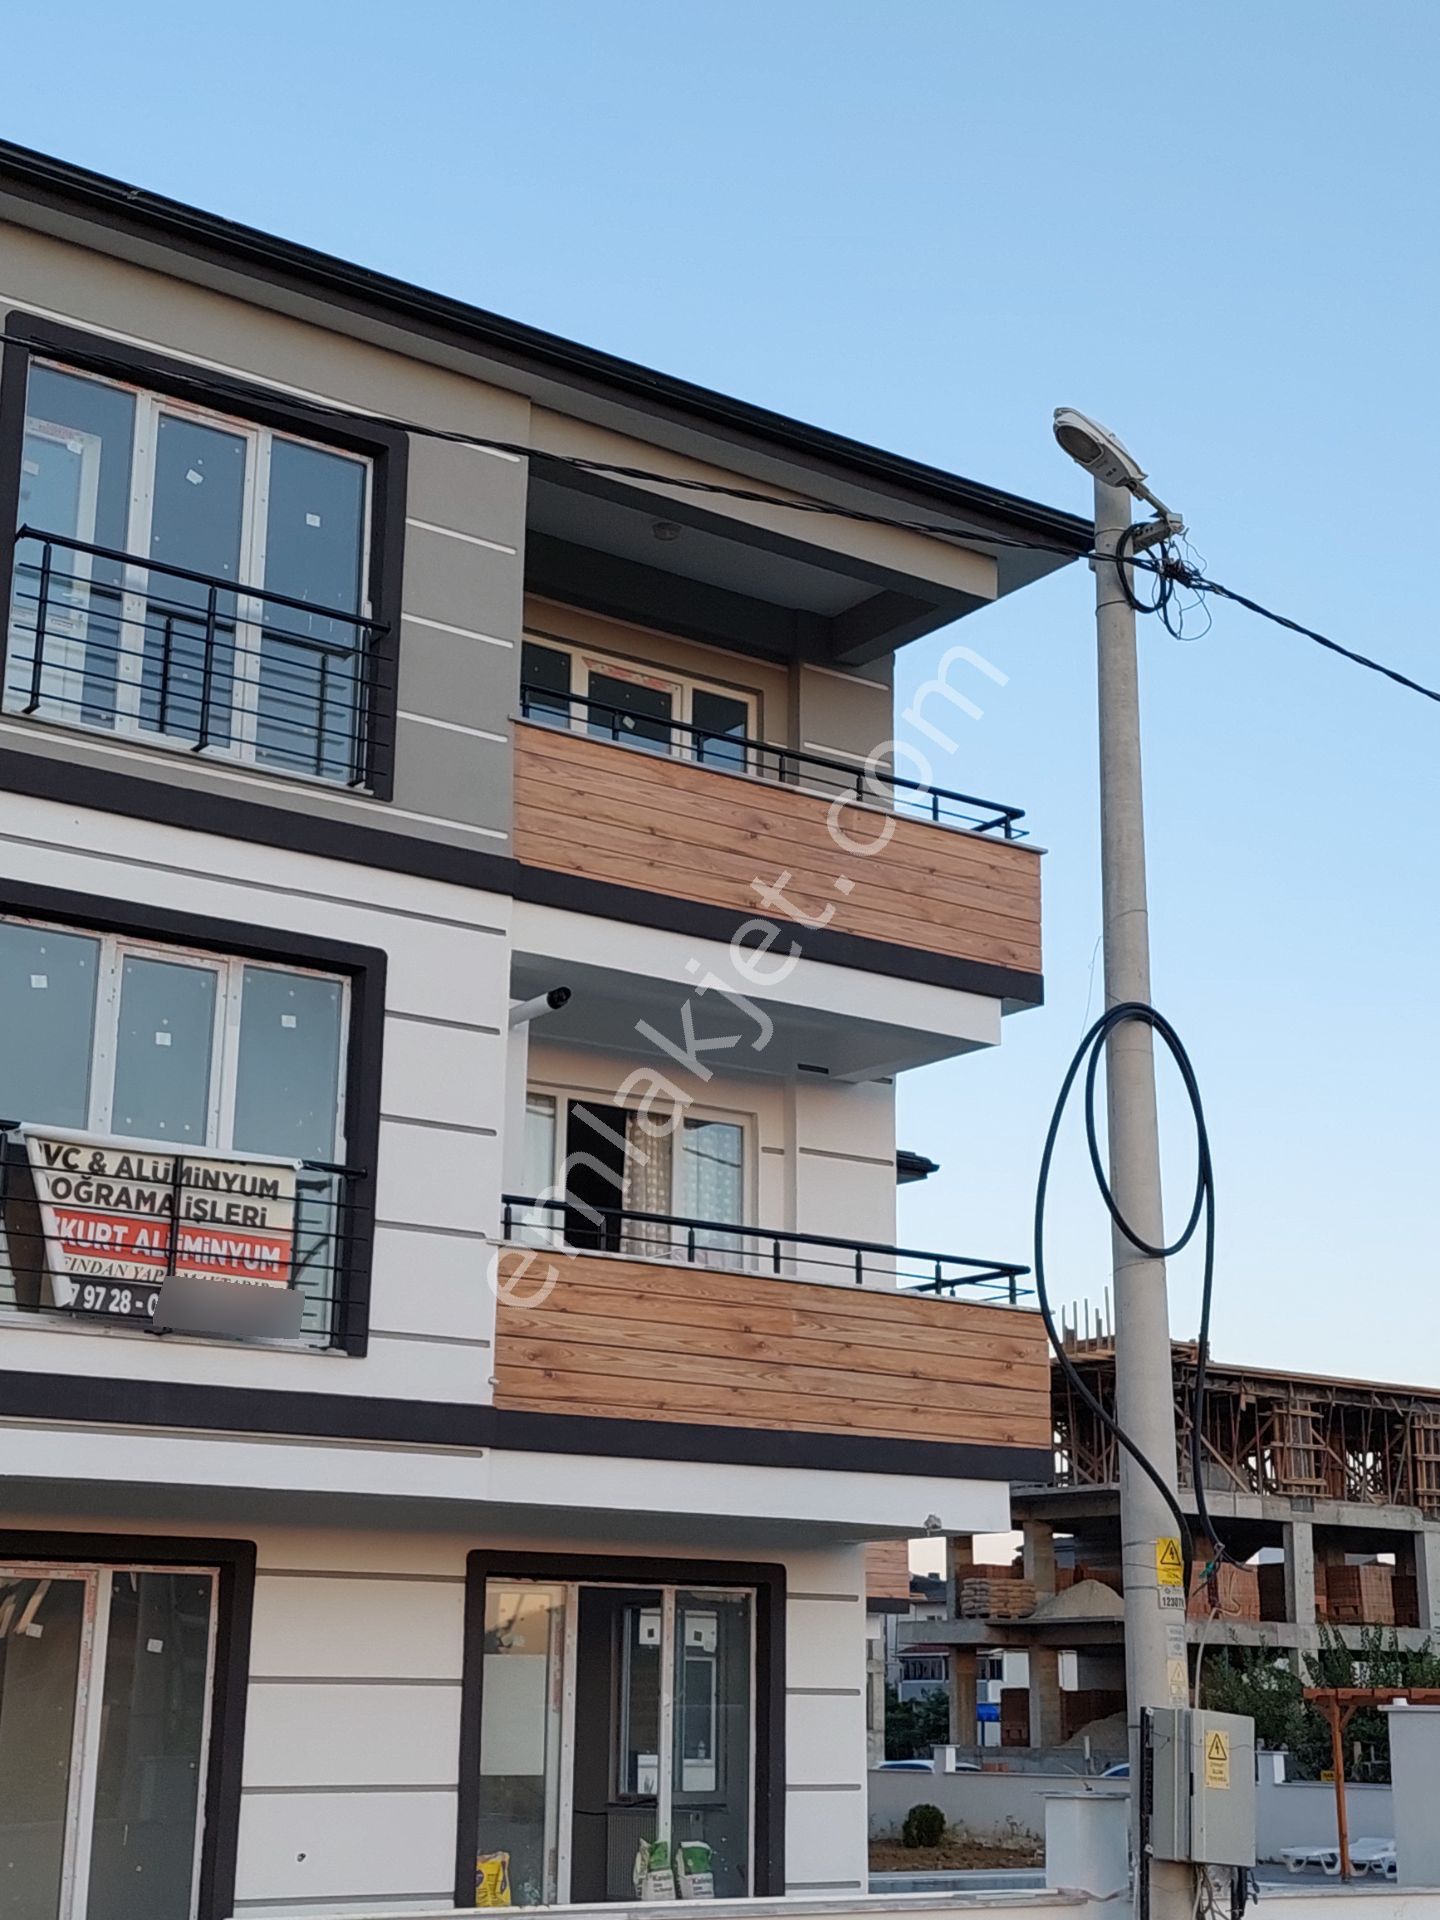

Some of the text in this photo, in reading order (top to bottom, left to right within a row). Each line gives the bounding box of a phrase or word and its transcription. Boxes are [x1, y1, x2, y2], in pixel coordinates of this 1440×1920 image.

[39, 1143, 81, 1170] VC
[88, 1151, 107, 1174] &
[46, 1175, 174, 1216] OĞRAMA
[55, 1215, 128, 1252] KURT
[83, 1284, 107, 1310] 97
[108, 1287, 132, 1314] 28
